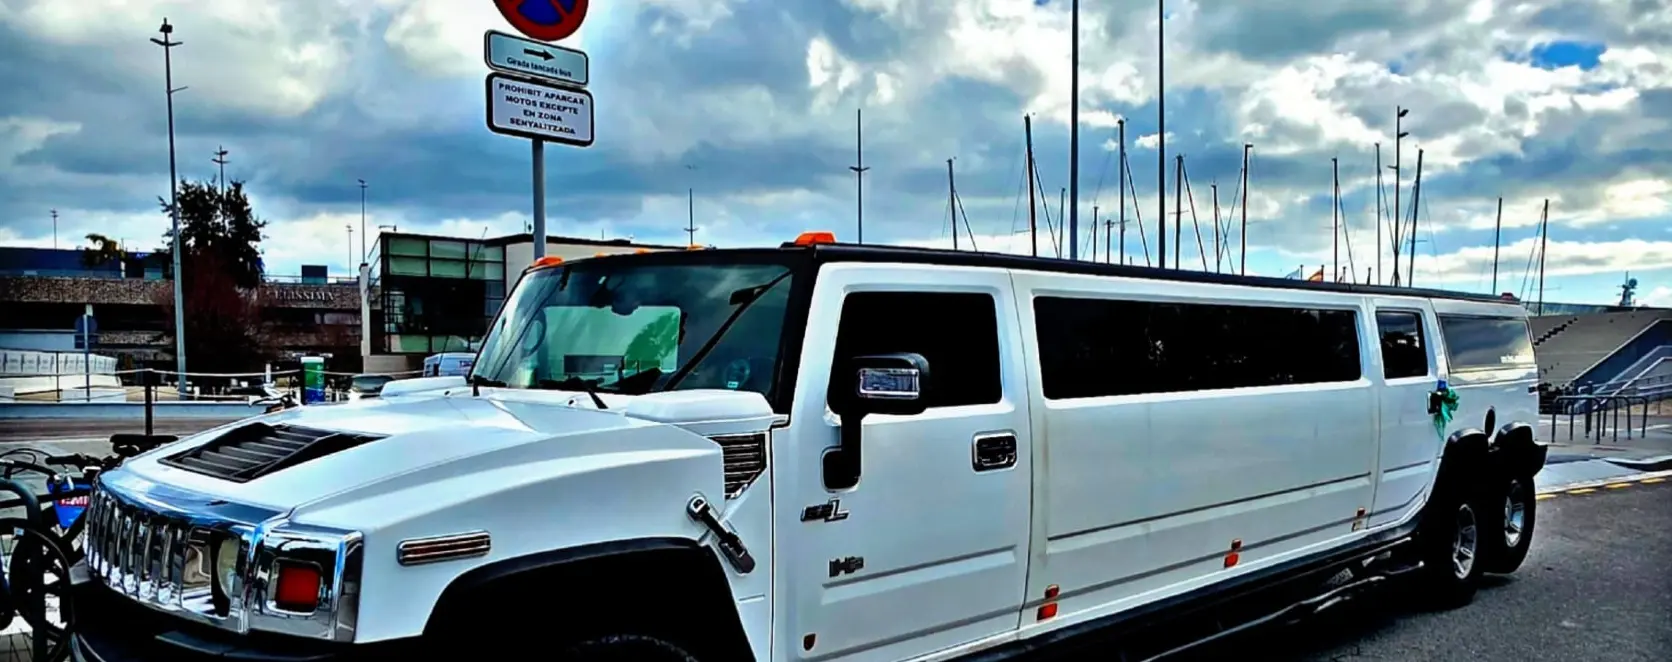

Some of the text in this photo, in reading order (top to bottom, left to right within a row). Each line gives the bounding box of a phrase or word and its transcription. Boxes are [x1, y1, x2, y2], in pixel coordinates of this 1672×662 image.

[531, 62, 558, 75] tancada
[559, 68, 572, 77] bus
[498, 83, 585, 105] PROHIBIT APARCAR
[505, 95, 578, 115] MOTOS EXCEPTE
[523, 109, 563, 122] EN ZONA
[509, 117, 576, 135] SENYALITZADA
